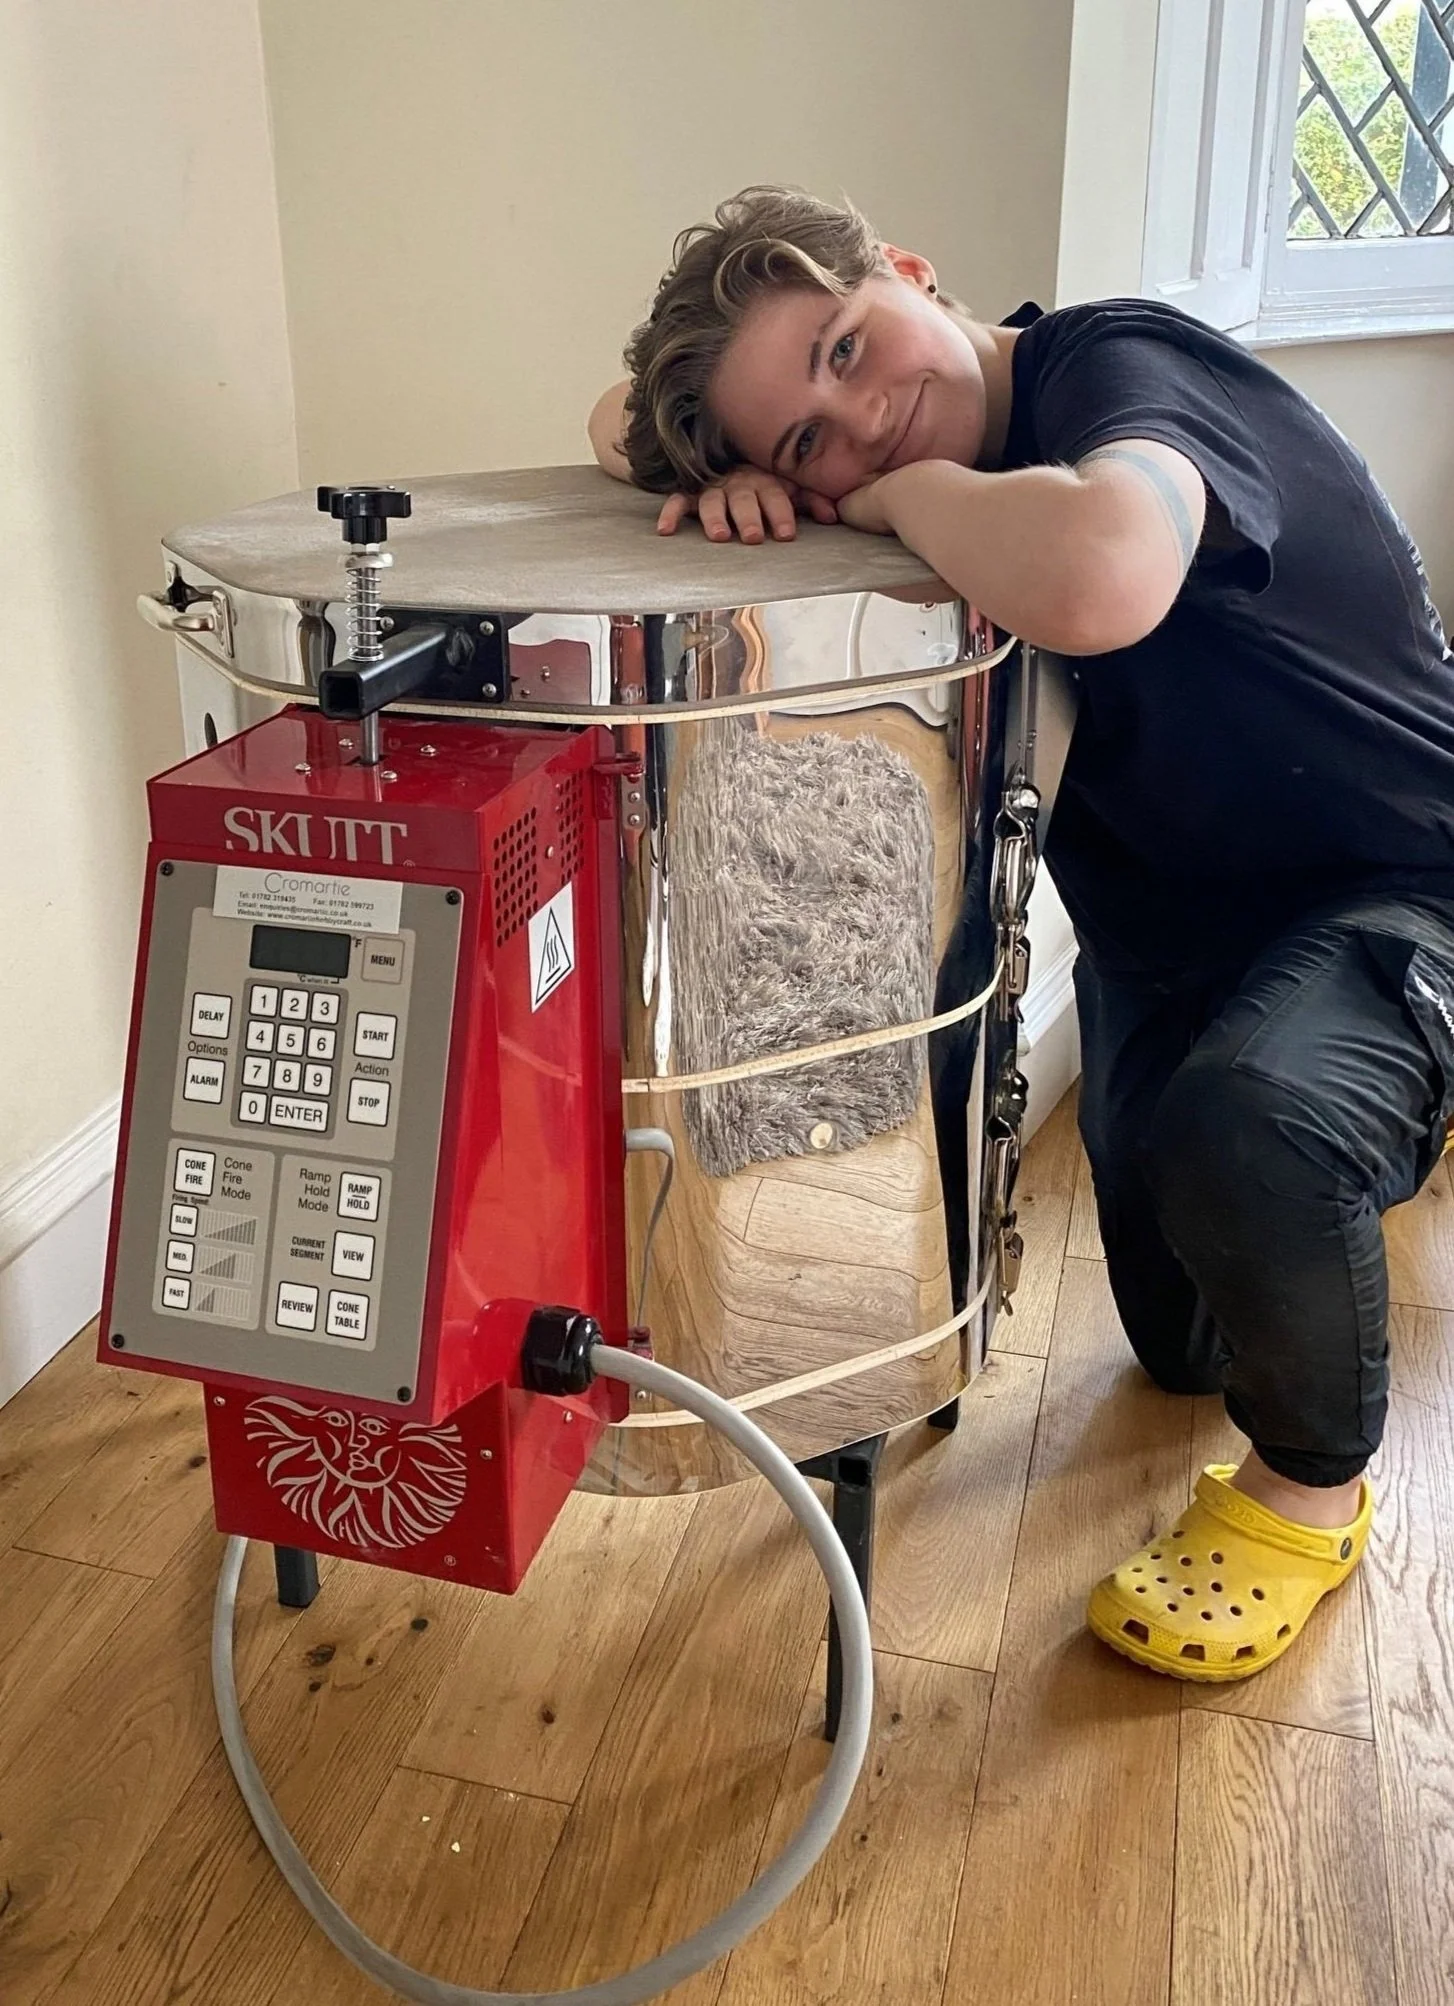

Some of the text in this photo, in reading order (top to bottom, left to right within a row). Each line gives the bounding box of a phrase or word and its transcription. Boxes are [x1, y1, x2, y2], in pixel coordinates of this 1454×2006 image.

[223, 806, 408, 865] SKUTT
[264, 872, 350, 896] Cromartie
[370, 954, 396, 966] MENU
[262, 994, 329, 1015] 1 2 3
[198, 1010, 224, 1022] DELAY
[256, 1030, 326, 1051] 4 5 6
[362, 1030, 389, 1042] START
[188, 1041, 229, 1056] Options
[354, 1062, 389, 1076] Action
[190, 1074, 219, 1086] ALARM
[252, 1065, 322, 1087] 7 8 9
[357, 1096, 380, 1108] STOP
[248, 1100, 323, 1124] 0 ENTER
[184, 1158, 207, 1171] CONE
[224, 1158, 253, 1172] Cone
[185, 1174, 203, 1186] FIRE
[222, 1172, 243, 1185] Fire
[300, 1168, 332, 1184] Ramp
[221, 1186, 252, 1201] Mode
[304, 1184, 330, 1198] Hold
[348, 1183, 373, 1196] RAMP
[298, 1198, 329, 1213] Mode
[346, 1198, 370, 1211] HOLD
[175, 1215, 193, 1226] SLOW
[292, 1236, 326, 1249] CURRENT
[172, 1252, 188, 1262] MED.
[290, 1248, 325, 1261] SEGMENT
[342, 1250, 364, 1262] VIEW
[169, 1288, 184, 1298] FAST
[281, 1300, 314, 1314] REVIEW
[336, 1301, 360, 1314] CONE
[334, 1316, 360, 1330] TABLE
